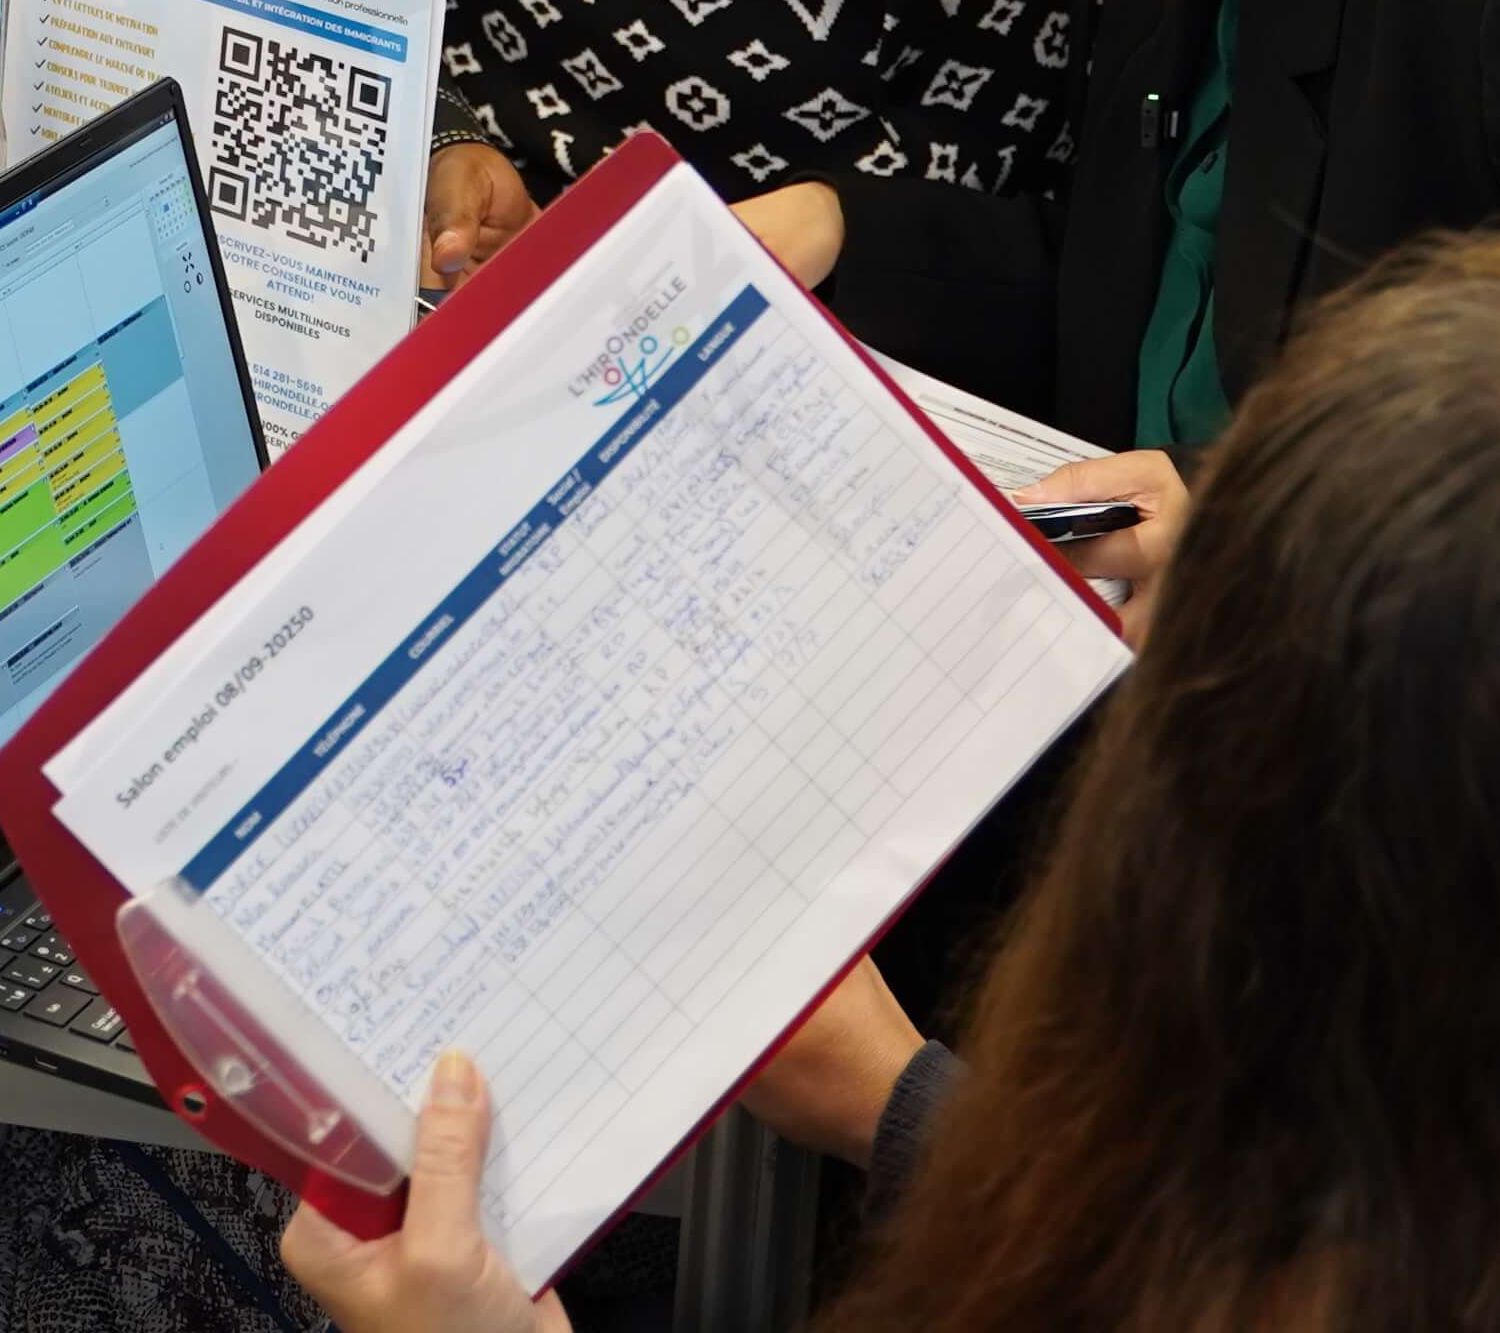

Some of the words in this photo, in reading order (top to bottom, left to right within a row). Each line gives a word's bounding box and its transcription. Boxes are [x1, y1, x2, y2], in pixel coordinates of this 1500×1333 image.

[264, 2, 324, 28] INTÉGRATION
[326, 20, 343, 35] DES
[344, 27, 402, 53] IMMIGRANTS
[223, 250, 260, 271] VOTRE
[262, 262, 328, 294] CONSEILLER
[330, 286, 362, 306] VOUS
[266, 279, 315, 303] ATTEND!
[305, 263, 381, 298] MAINTENANT
[255, 310, 320, 339] DISPONIBLES
[277, 304, 351, 338] MULTILINGUES
[568, 275, 686, 399] L'HIRONDELLE
[253, 363, 270, 378] 514
[116, 760, 163, 809] Salon
[164, 703, 218, 764] emploi
[214, 605, 314, 708] 08/09-20250
